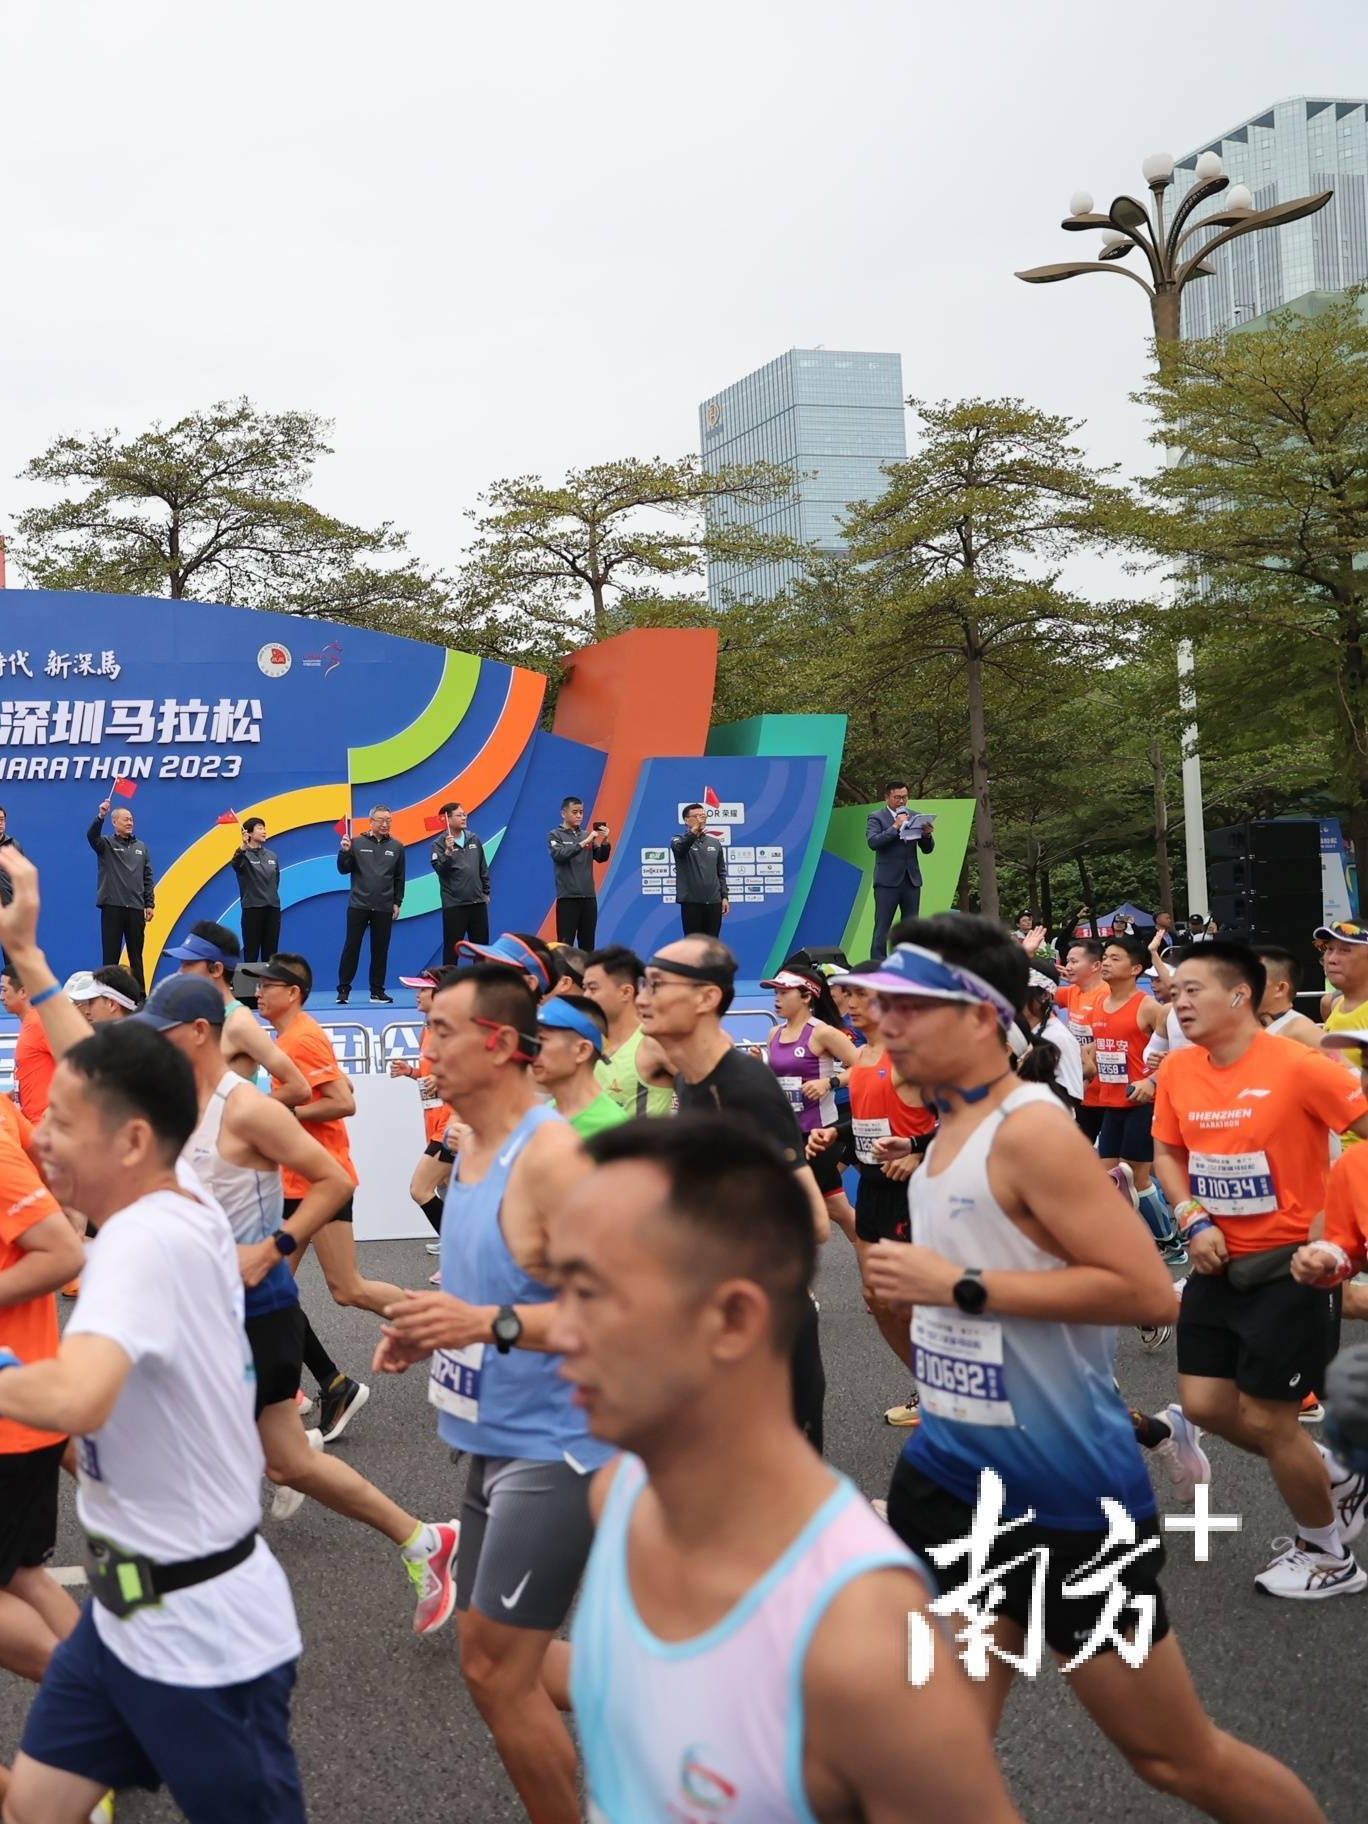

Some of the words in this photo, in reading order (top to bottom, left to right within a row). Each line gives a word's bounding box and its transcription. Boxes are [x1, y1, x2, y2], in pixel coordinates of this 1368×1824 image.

[158, 755, 243, 779] 2023
[1188, 1107, 1253, 1121] SHENZHEN
[1197, 1177, 1257, 1198] B11034
